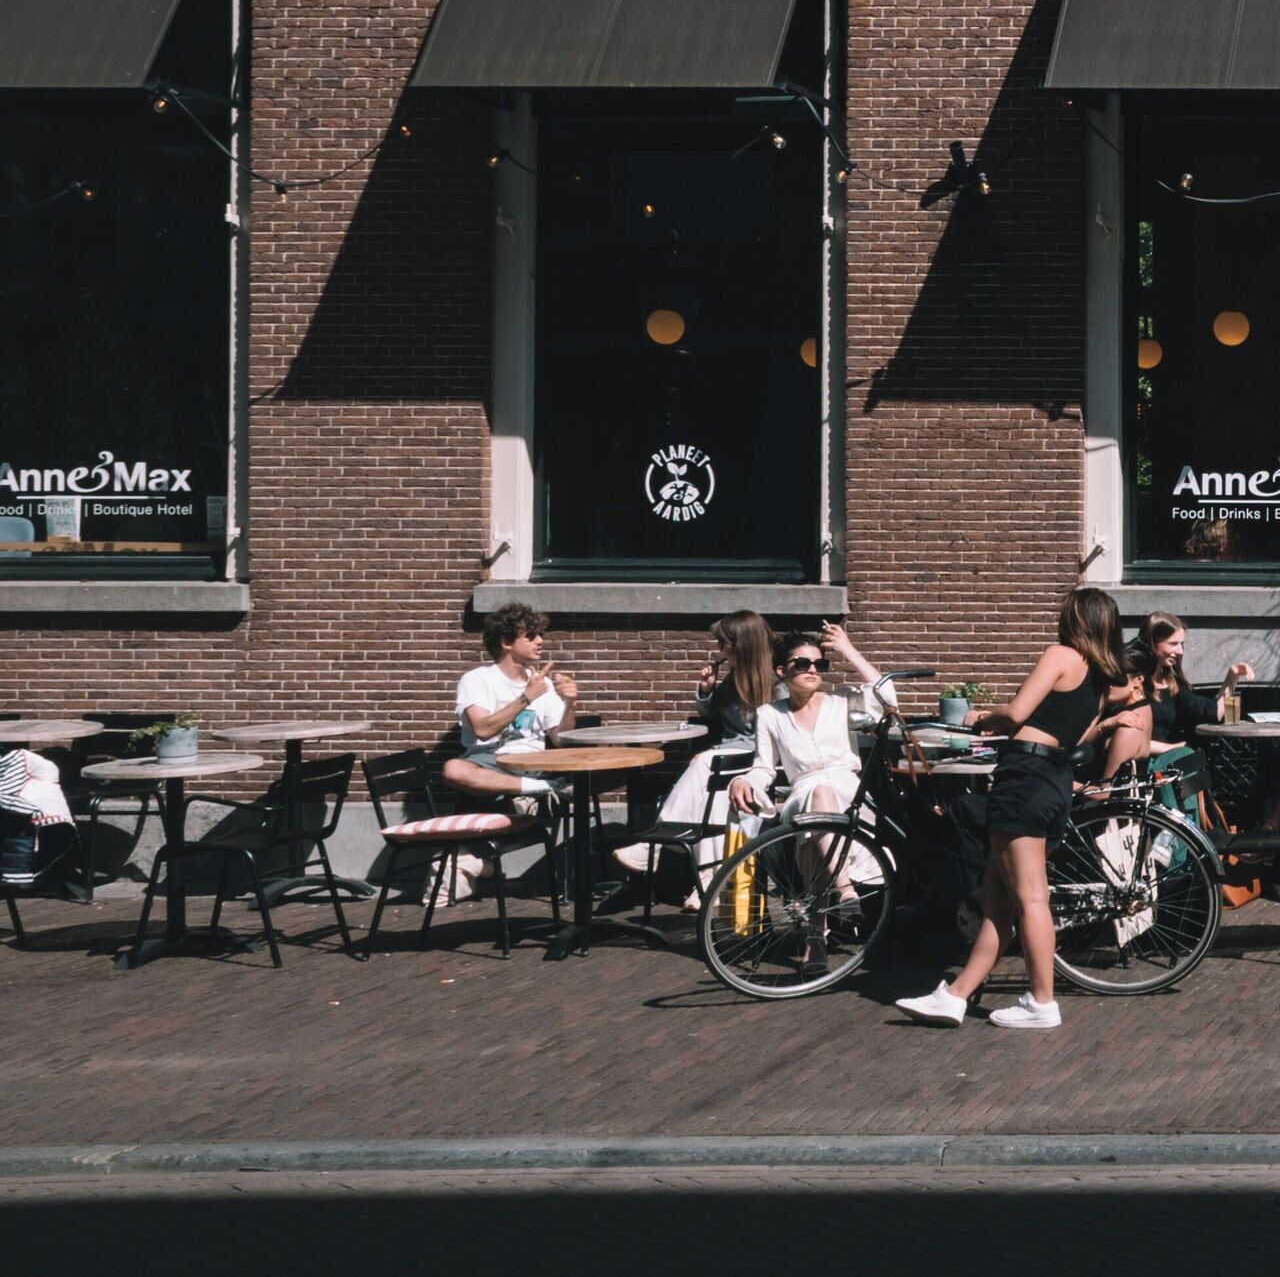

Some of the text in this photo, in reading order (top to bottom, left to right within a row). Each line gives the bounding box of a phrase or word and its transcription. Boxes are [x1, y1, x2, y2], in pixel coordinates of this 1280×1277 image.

[651, 444, 711, 467] PLANEET
[0, 504, 24, 515] ood
[93, 504, 153, 517] Boutique
[157, 504, 193, 515] Hotel
[652, 501, 706, 521] AARDIG
[1172, 507, 1205, 519] Food
[1219, 507, 1261, 519] Drinks
